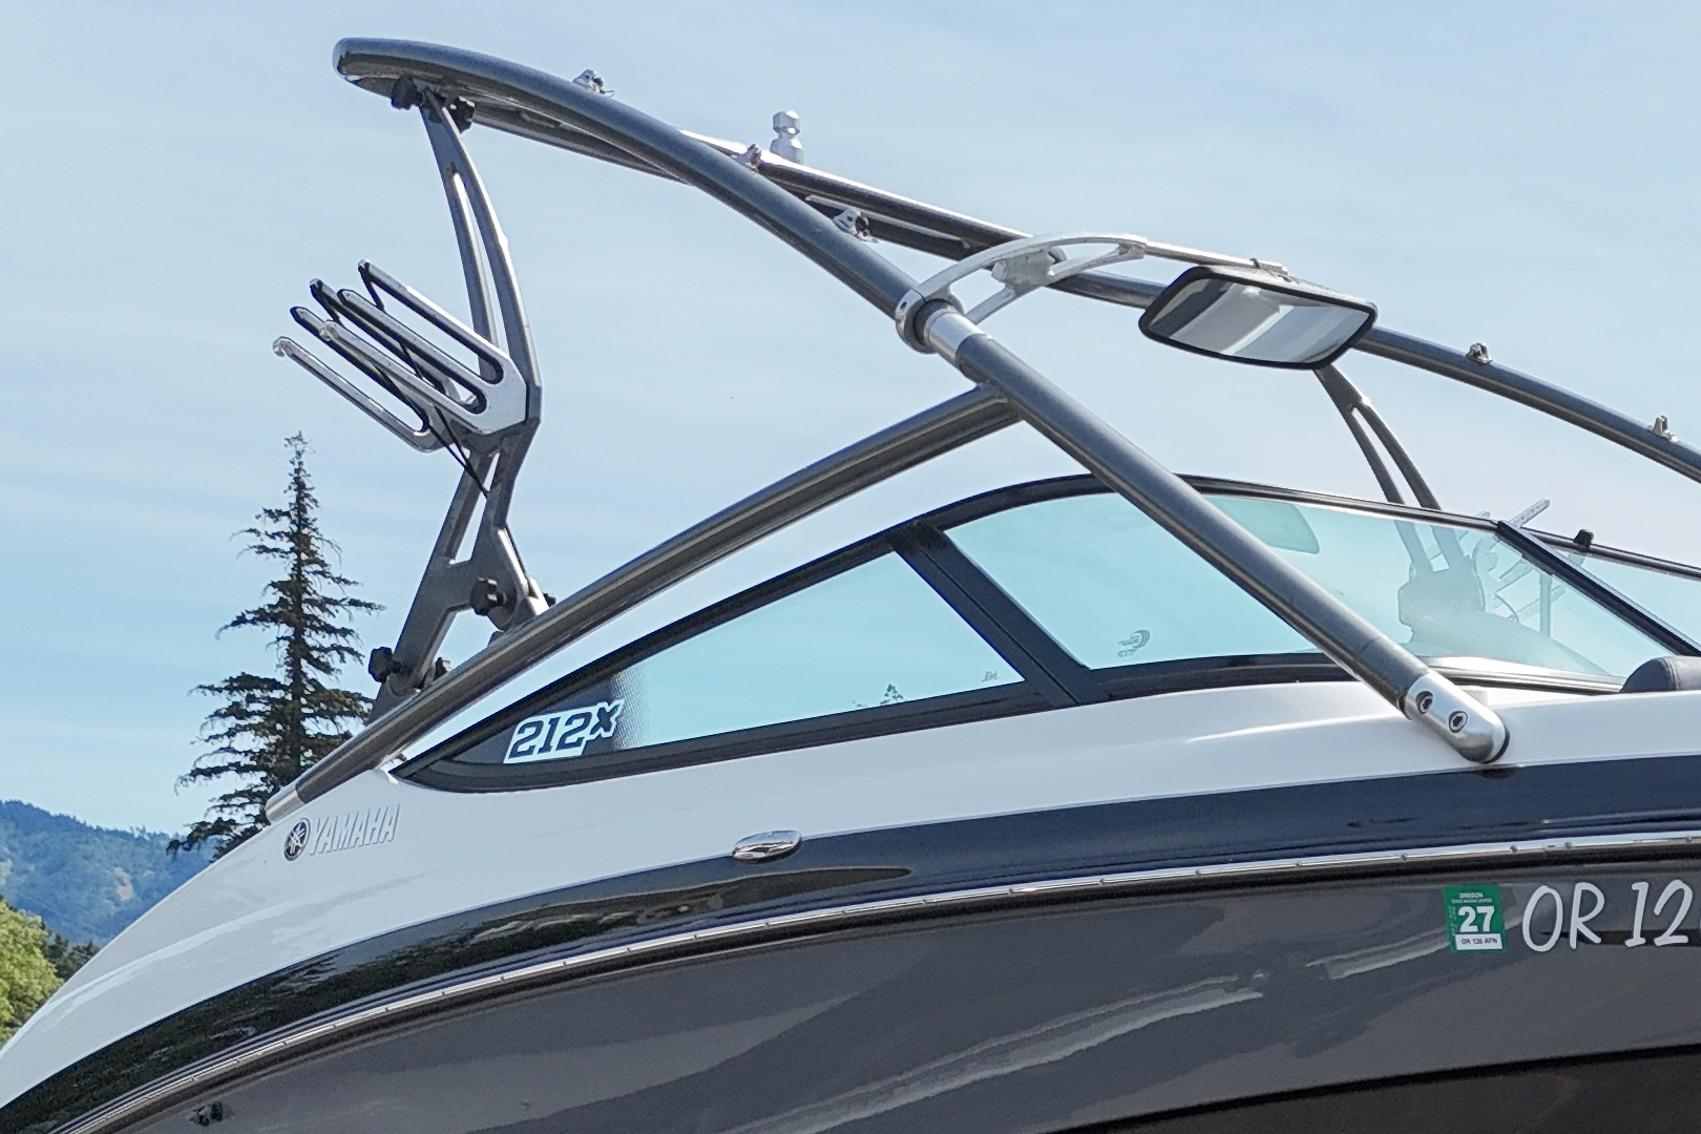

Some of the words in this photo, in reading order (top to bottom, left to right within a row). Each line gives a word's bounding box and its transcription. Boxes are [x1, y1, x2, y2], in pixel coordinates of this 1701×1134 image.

[506, 699, 624, 761] 212X
[309, 804, 400, 856] YAMAHA
[1458, 905, 1495, 932] 27
[1522, 881, 1605, 952] OR
